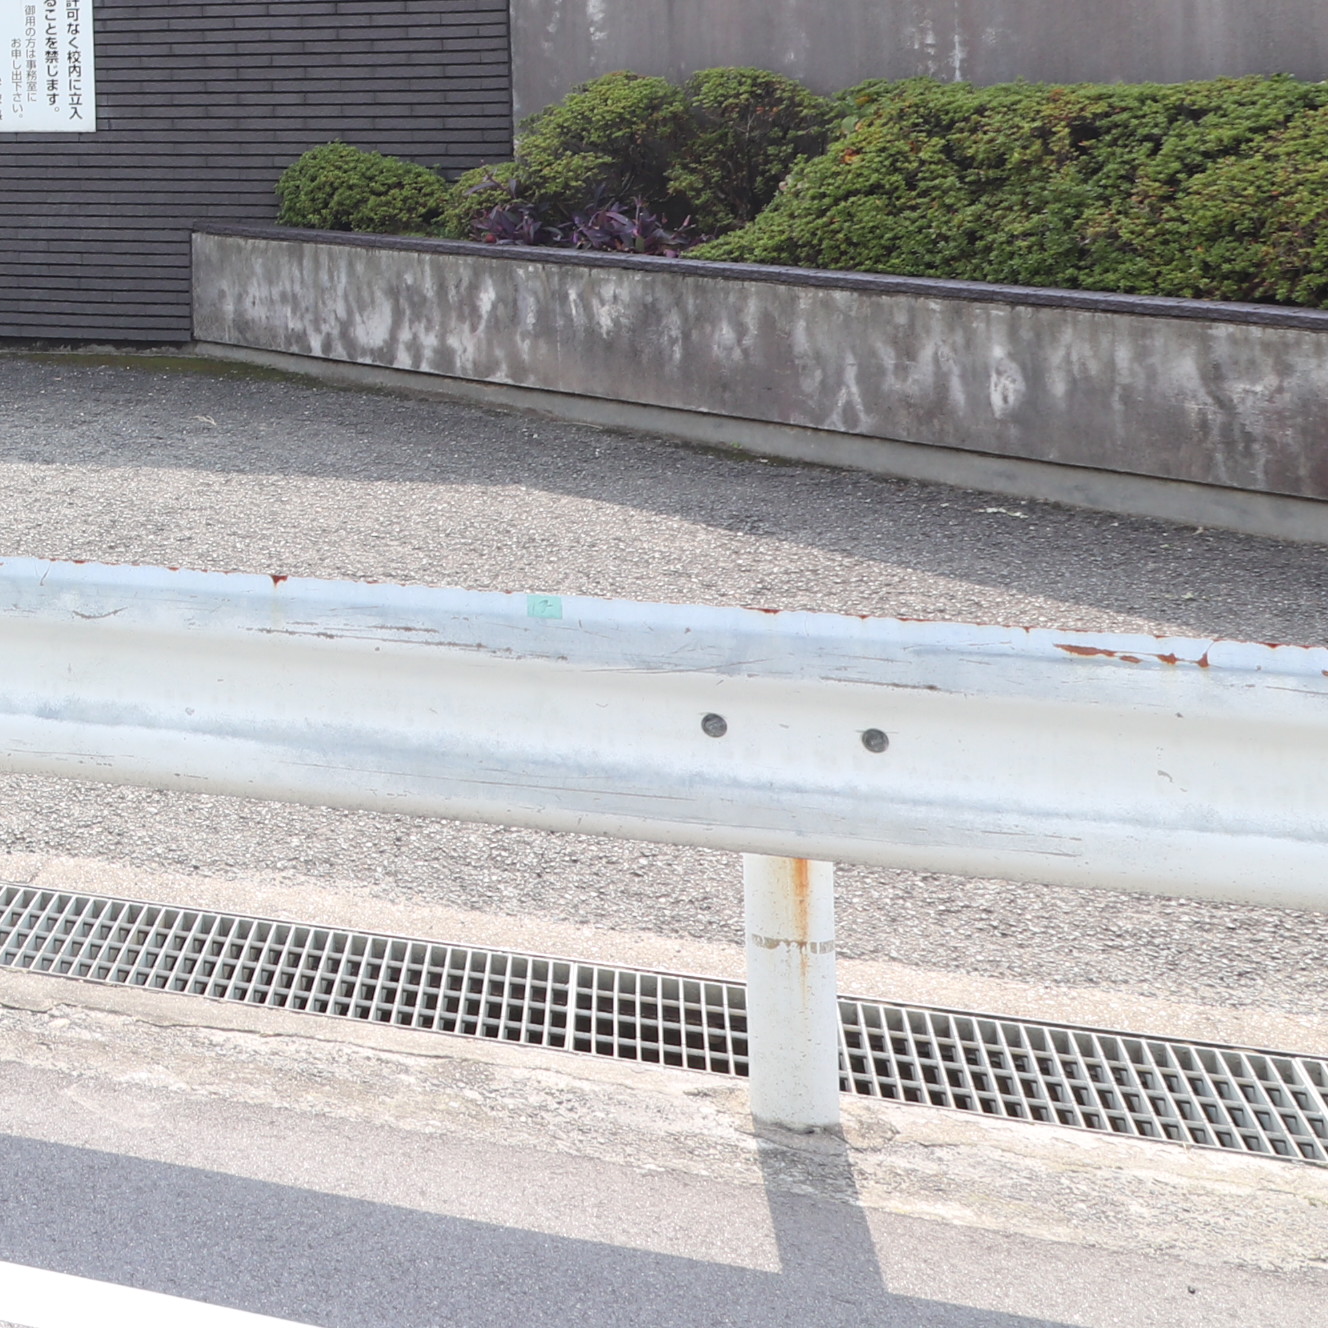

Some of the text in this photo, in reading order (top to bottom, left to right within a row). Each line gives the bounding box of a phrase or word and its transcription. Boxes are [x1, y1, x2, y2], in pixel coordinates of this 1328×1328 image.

[11, 38, 24, 119] お申し出下さい。
[24, 4, 38, 103] 御用の方は事務室に
